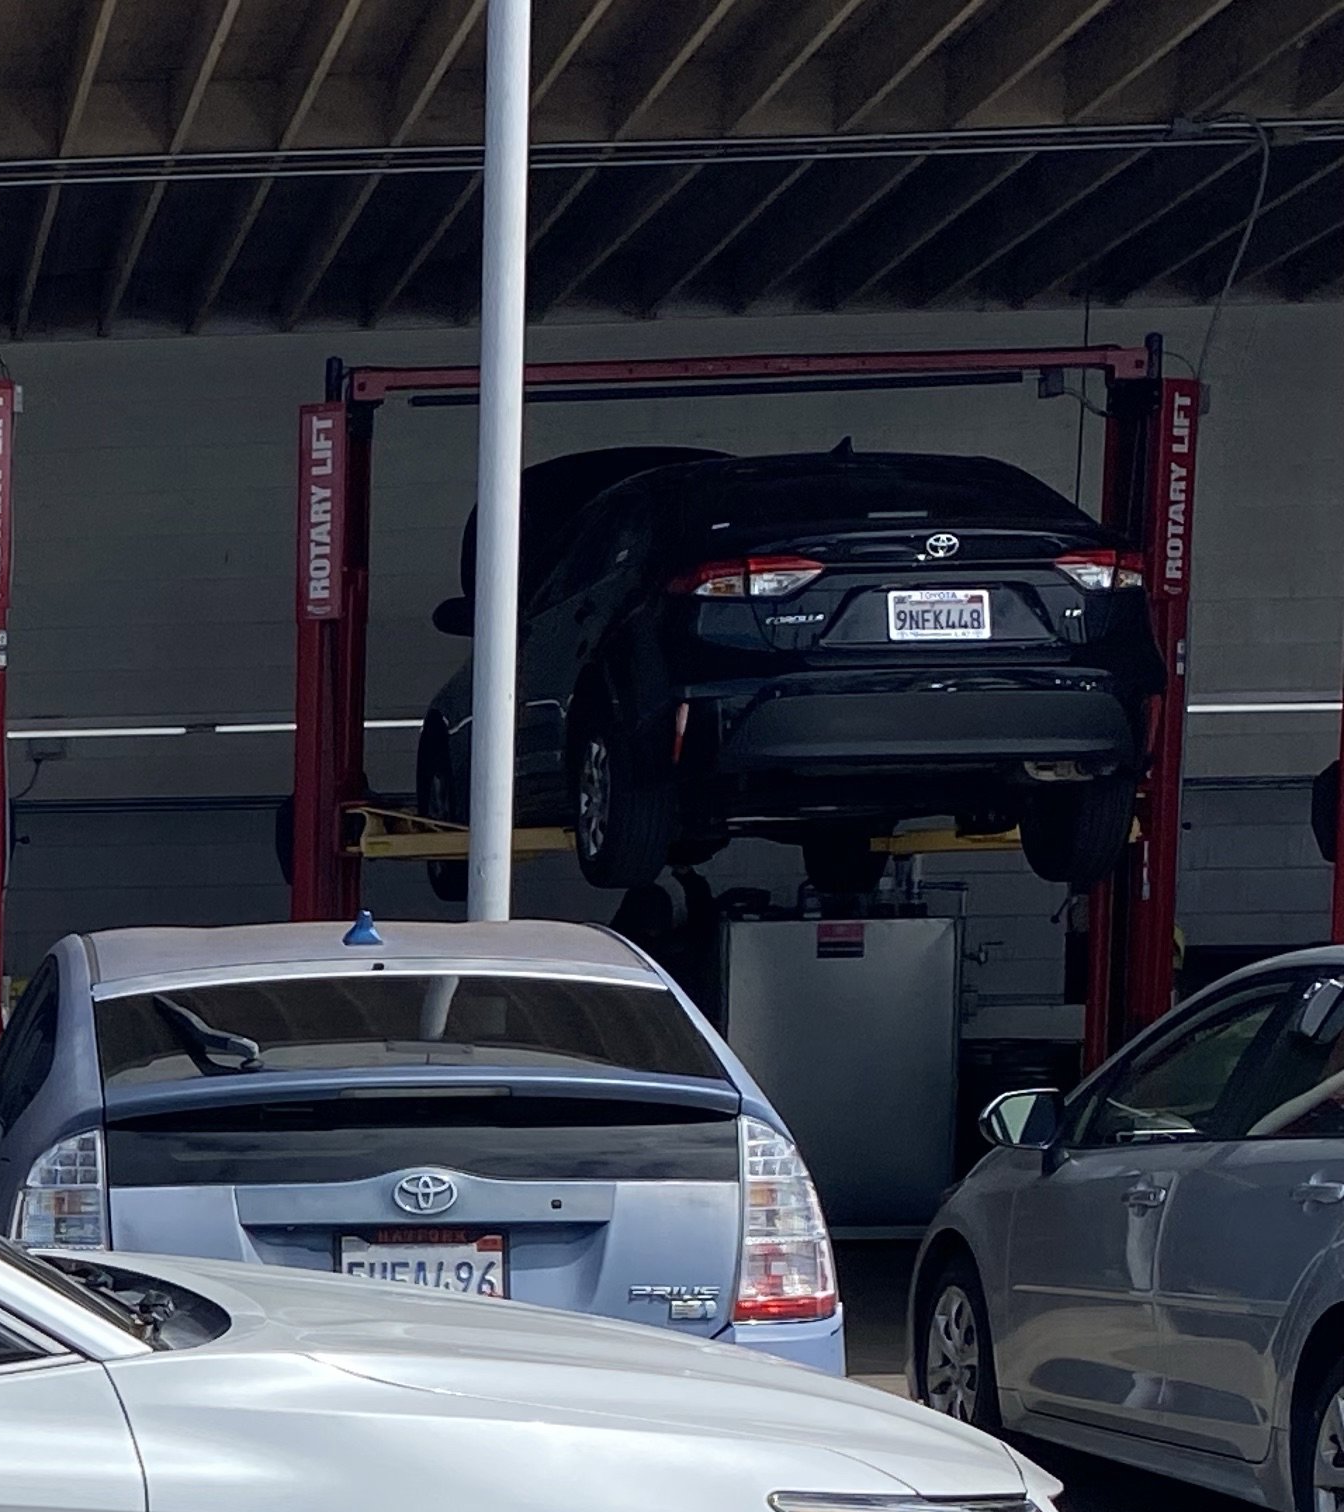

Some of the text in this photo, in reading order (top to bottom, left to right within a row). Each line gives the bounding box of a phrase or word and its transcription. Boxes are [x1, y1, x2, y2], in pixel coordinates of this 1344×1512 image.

[1166, 392, 1191, 578] ROTARY LIFT
[309, 416, 333, 599] ROTARY LIFT
[919, 591, 958, 600] TOYOTA
[896, 608, 982, 631] 9NFK448
[628, 1285, 721, 1300] PRIUS
